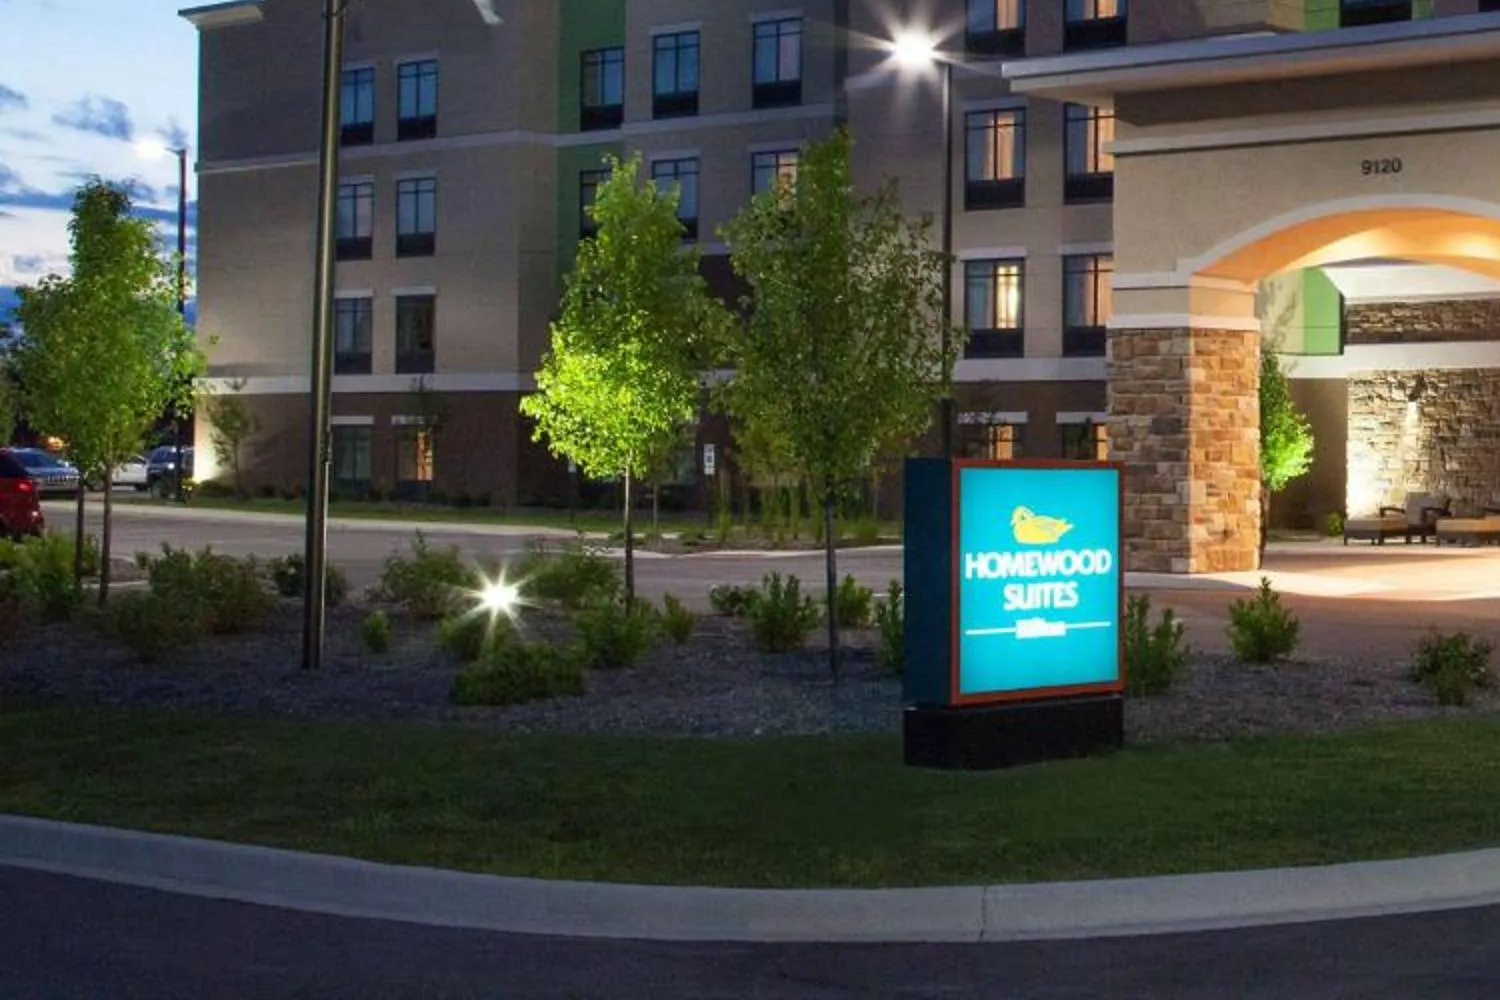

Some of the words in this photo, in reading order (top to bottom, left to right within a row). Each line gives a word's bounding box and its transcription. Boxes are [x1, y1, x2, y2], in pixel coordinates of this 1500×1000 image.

[1361, 158, 1402, 175] 9120
[965, 549, 1112, 579] HOMEWOOD
[1003, 582, 1079, 611] SUITES
